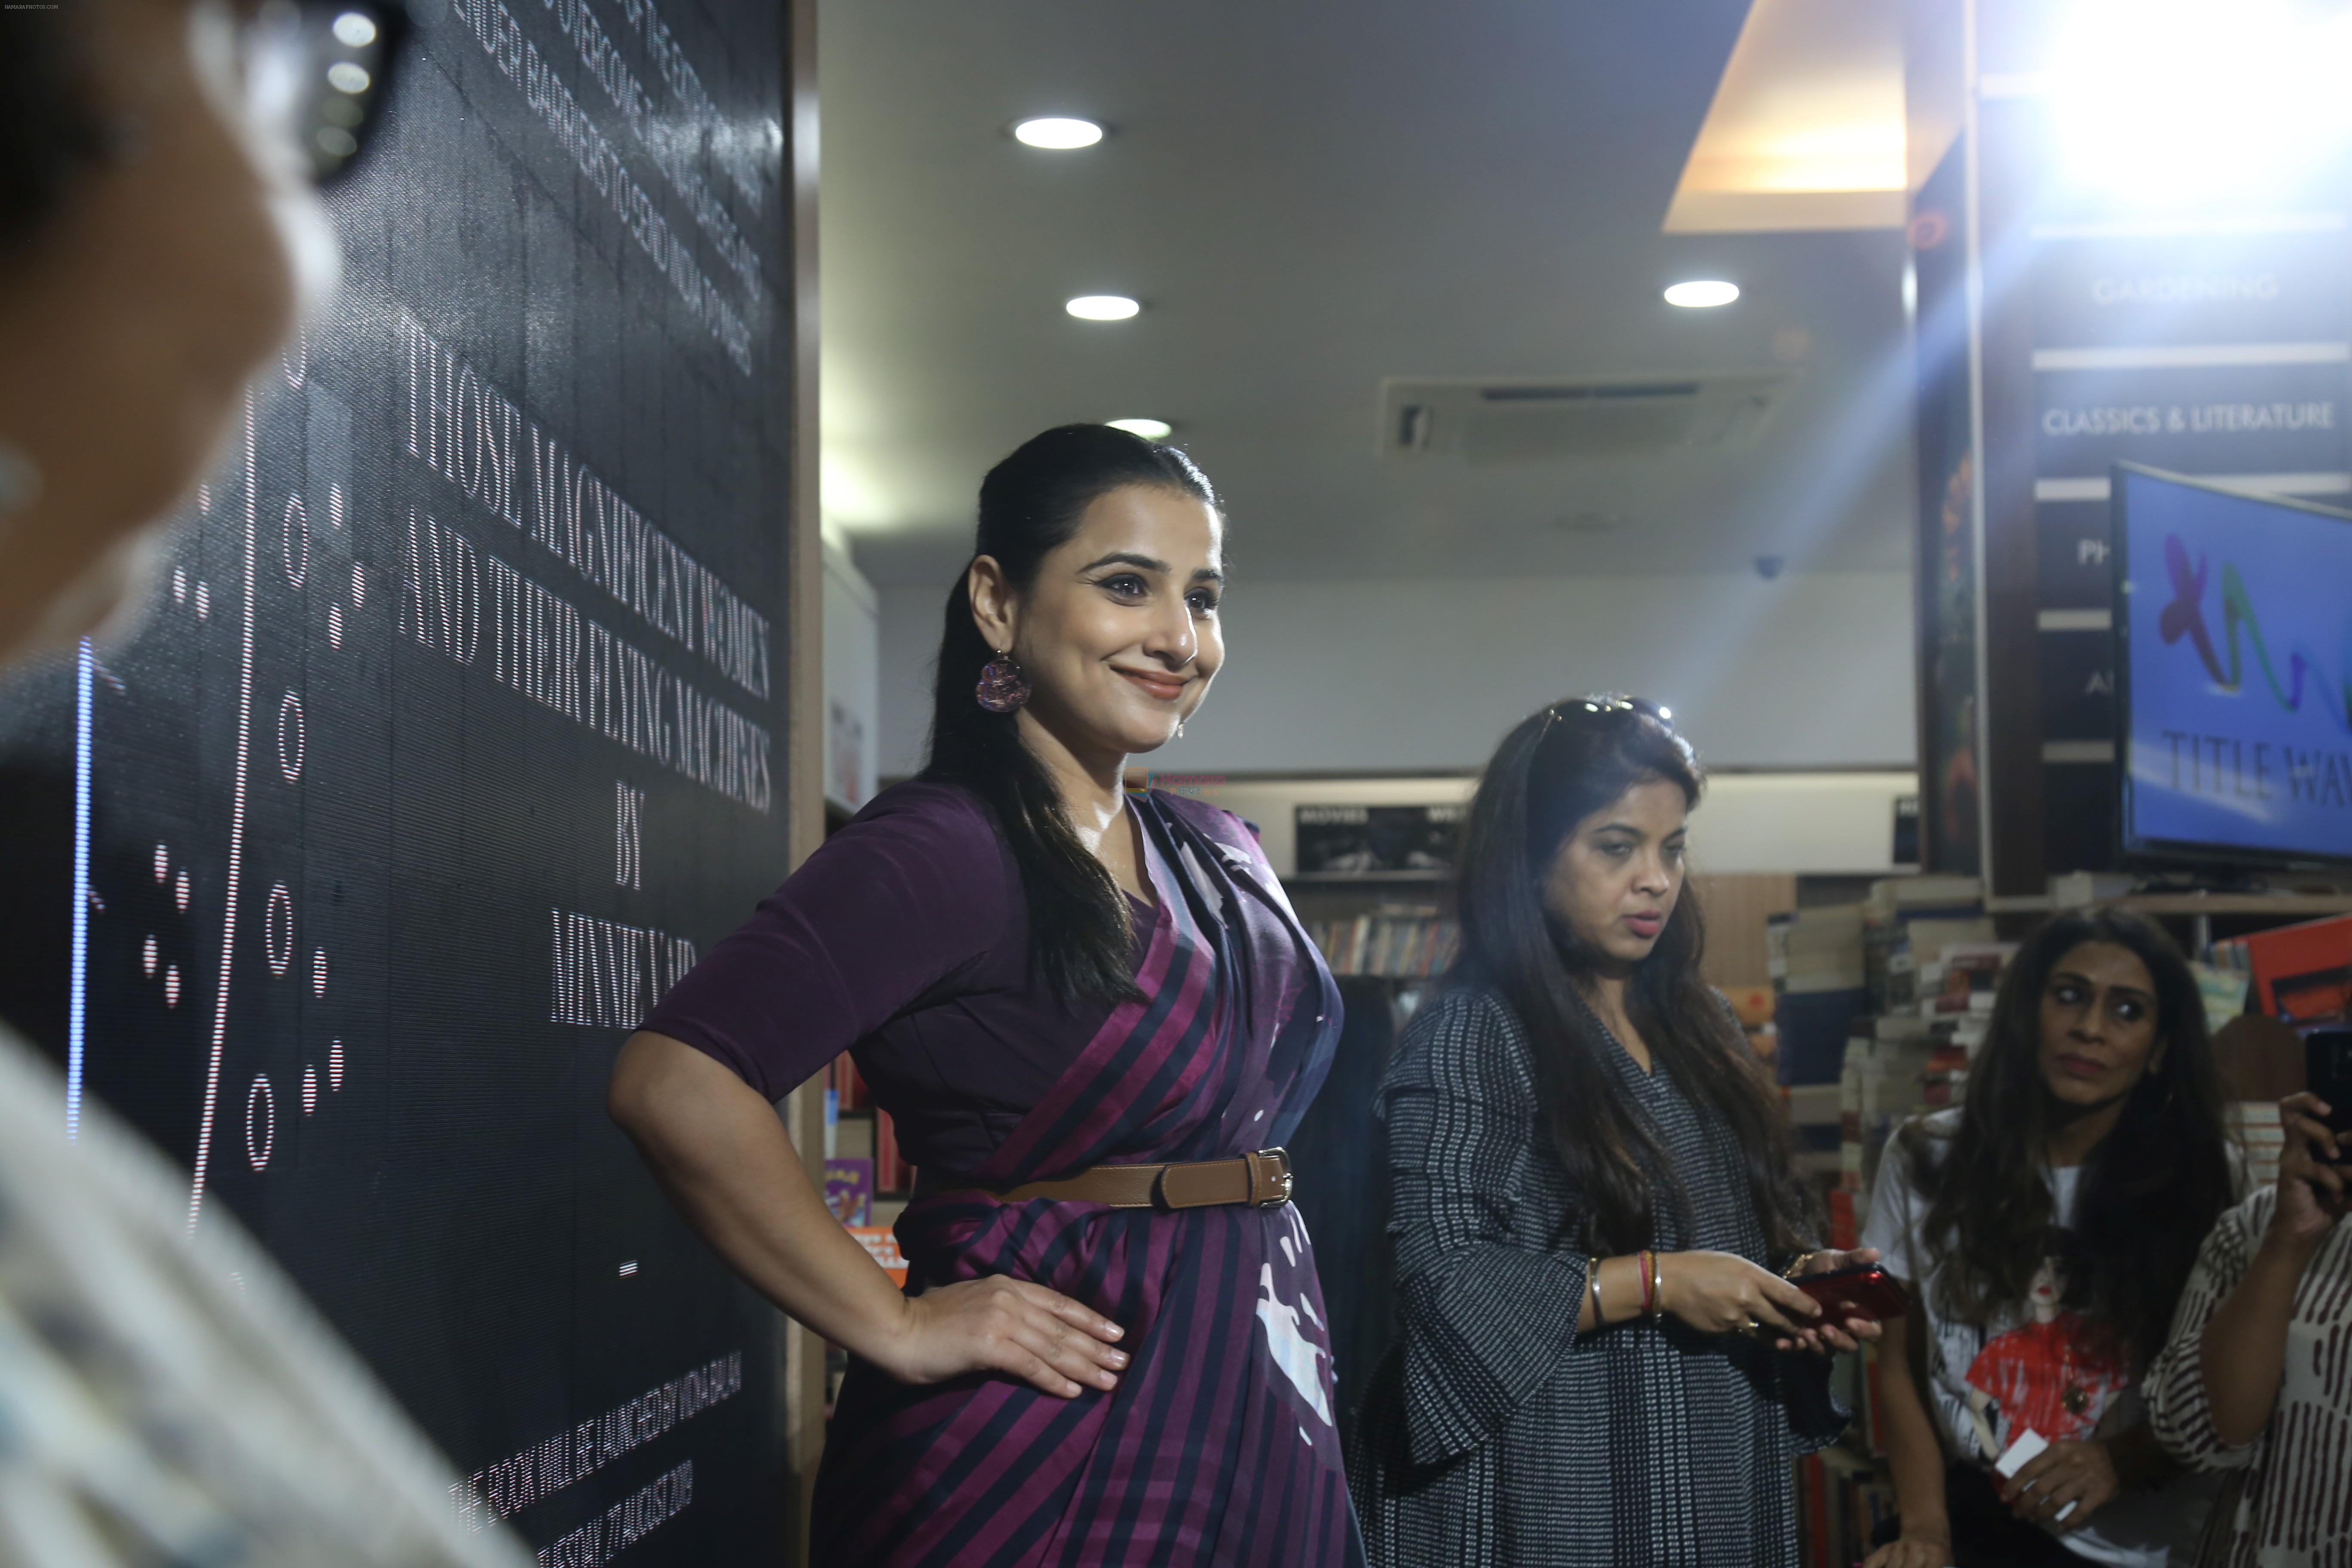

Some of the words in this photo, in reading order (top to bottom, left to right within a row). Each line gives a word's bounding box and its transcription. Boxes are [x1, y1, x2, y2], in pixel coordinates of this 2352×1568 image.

[527, 39, 607, 199] BARRIERS
[2091, 272, 2280, 306] GARDENING
[2043, 405, 2162, 438] CLASSICS
[2165, 405, 2186, 433] &
[2190, 401, 2336, 434] LITERATURE
[400, 304, 522, 529] THOSE
[530, 422, 698, 652] MAGNIFICENT
[699, 565, 769, 702] WOMEN
[395, 503, 479, 665] AND
[488, 554, 581, 724] THEIR
[588, 619, 671, 767] FLYING
[675, 675, 770, 814] MACHINES
[2162, 730, 2274, 803] TITLE
[616, 779, 645, 891] BY
[551, 906, 644, 1029] MINNIE
[447, 1467, 483, 1537] THE
[488, 1445, 536, 1528] BOOK
[539, 1429, 573, 1500] WILL
[576, 1417, 594, 1481] BE
[596, 1387, 661, 1469] LAUNCHED
[662, 1377, 678, 1433] BY
[678, 1363, 709, 1421] VIDYA
[710, 1350, 742, 1407] BALAN
[606, 1501, 622, 1564] 27
[621, 1472, 668, 1550] AUGUST
